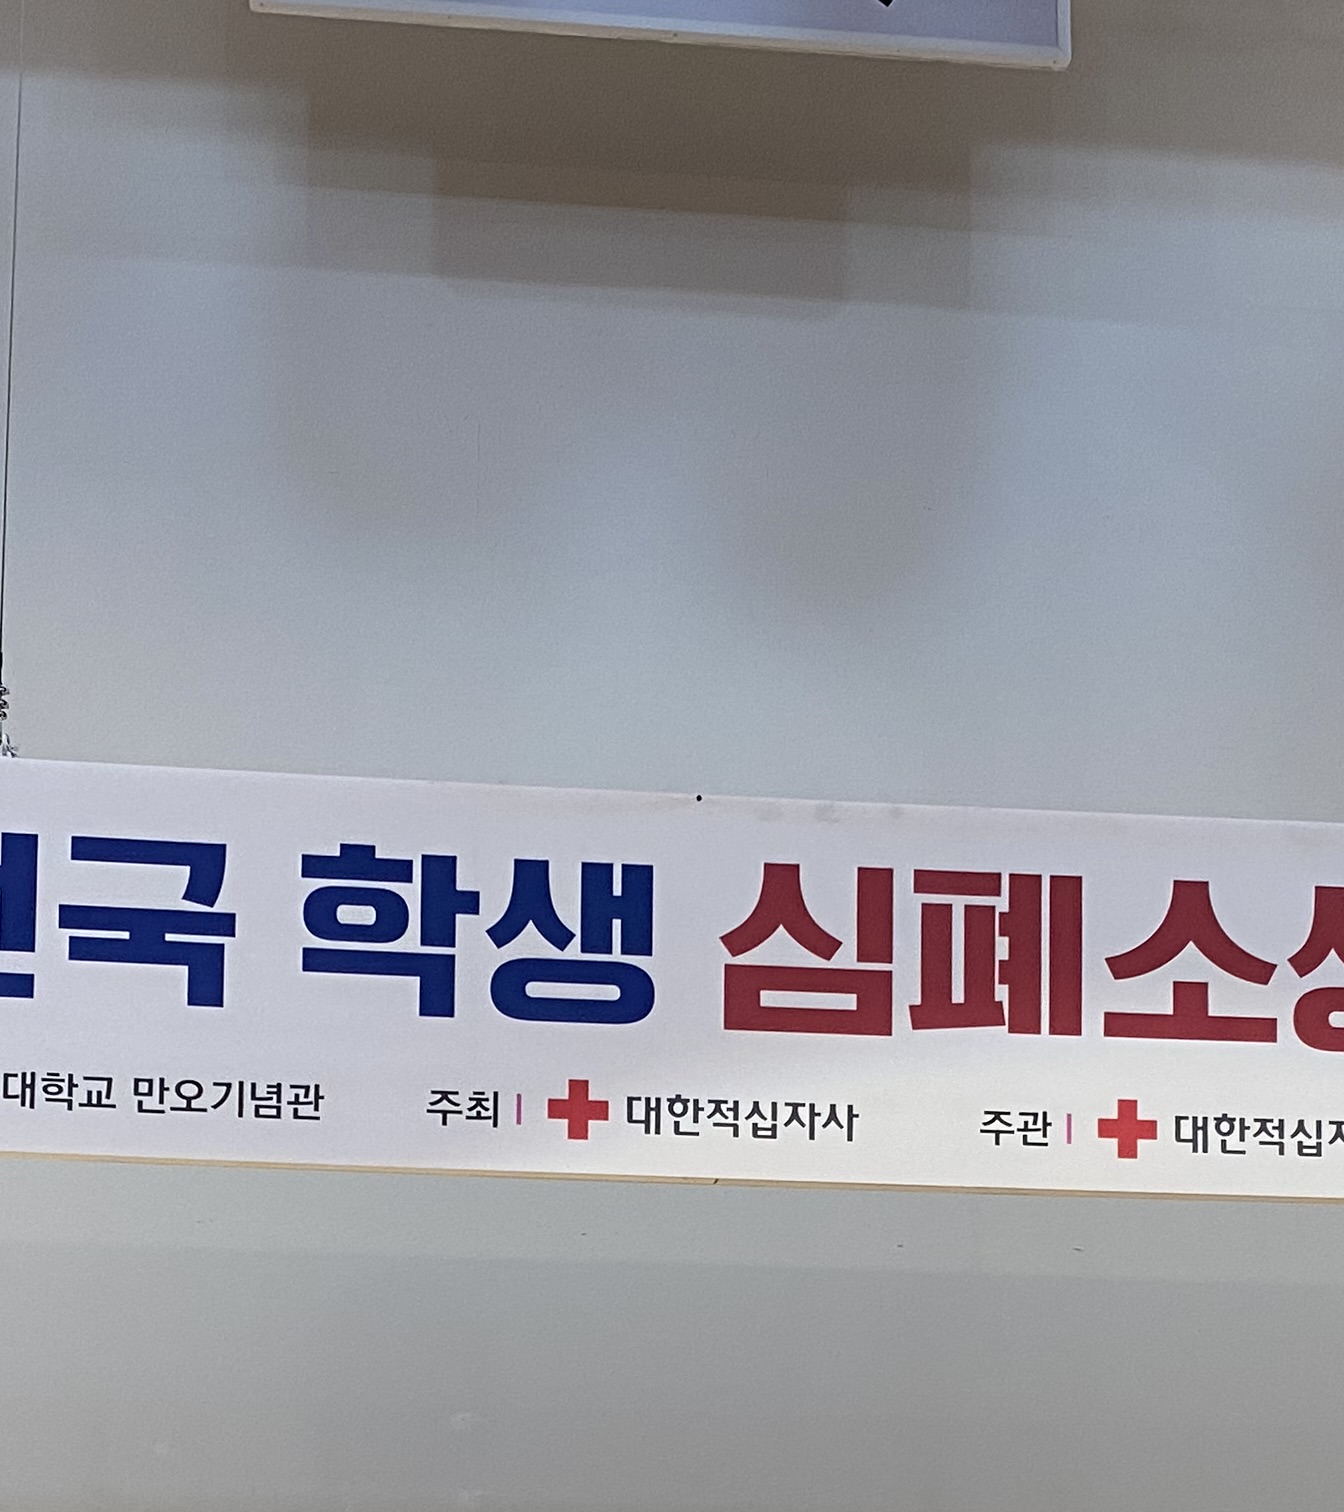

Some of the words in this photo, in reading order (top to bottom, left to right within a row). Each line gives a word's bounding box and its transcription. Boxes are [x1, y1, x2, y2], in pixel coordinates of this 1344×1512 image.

[301, 843, 655, 1024] 학생
[134, 1078, 324, 1120] 만오기념관
[427, 1090, 498, 1128] 주최
[627, 1094, 859, 1141] 대한적십자사
[980, 1111, 1052, 1146] 주관
